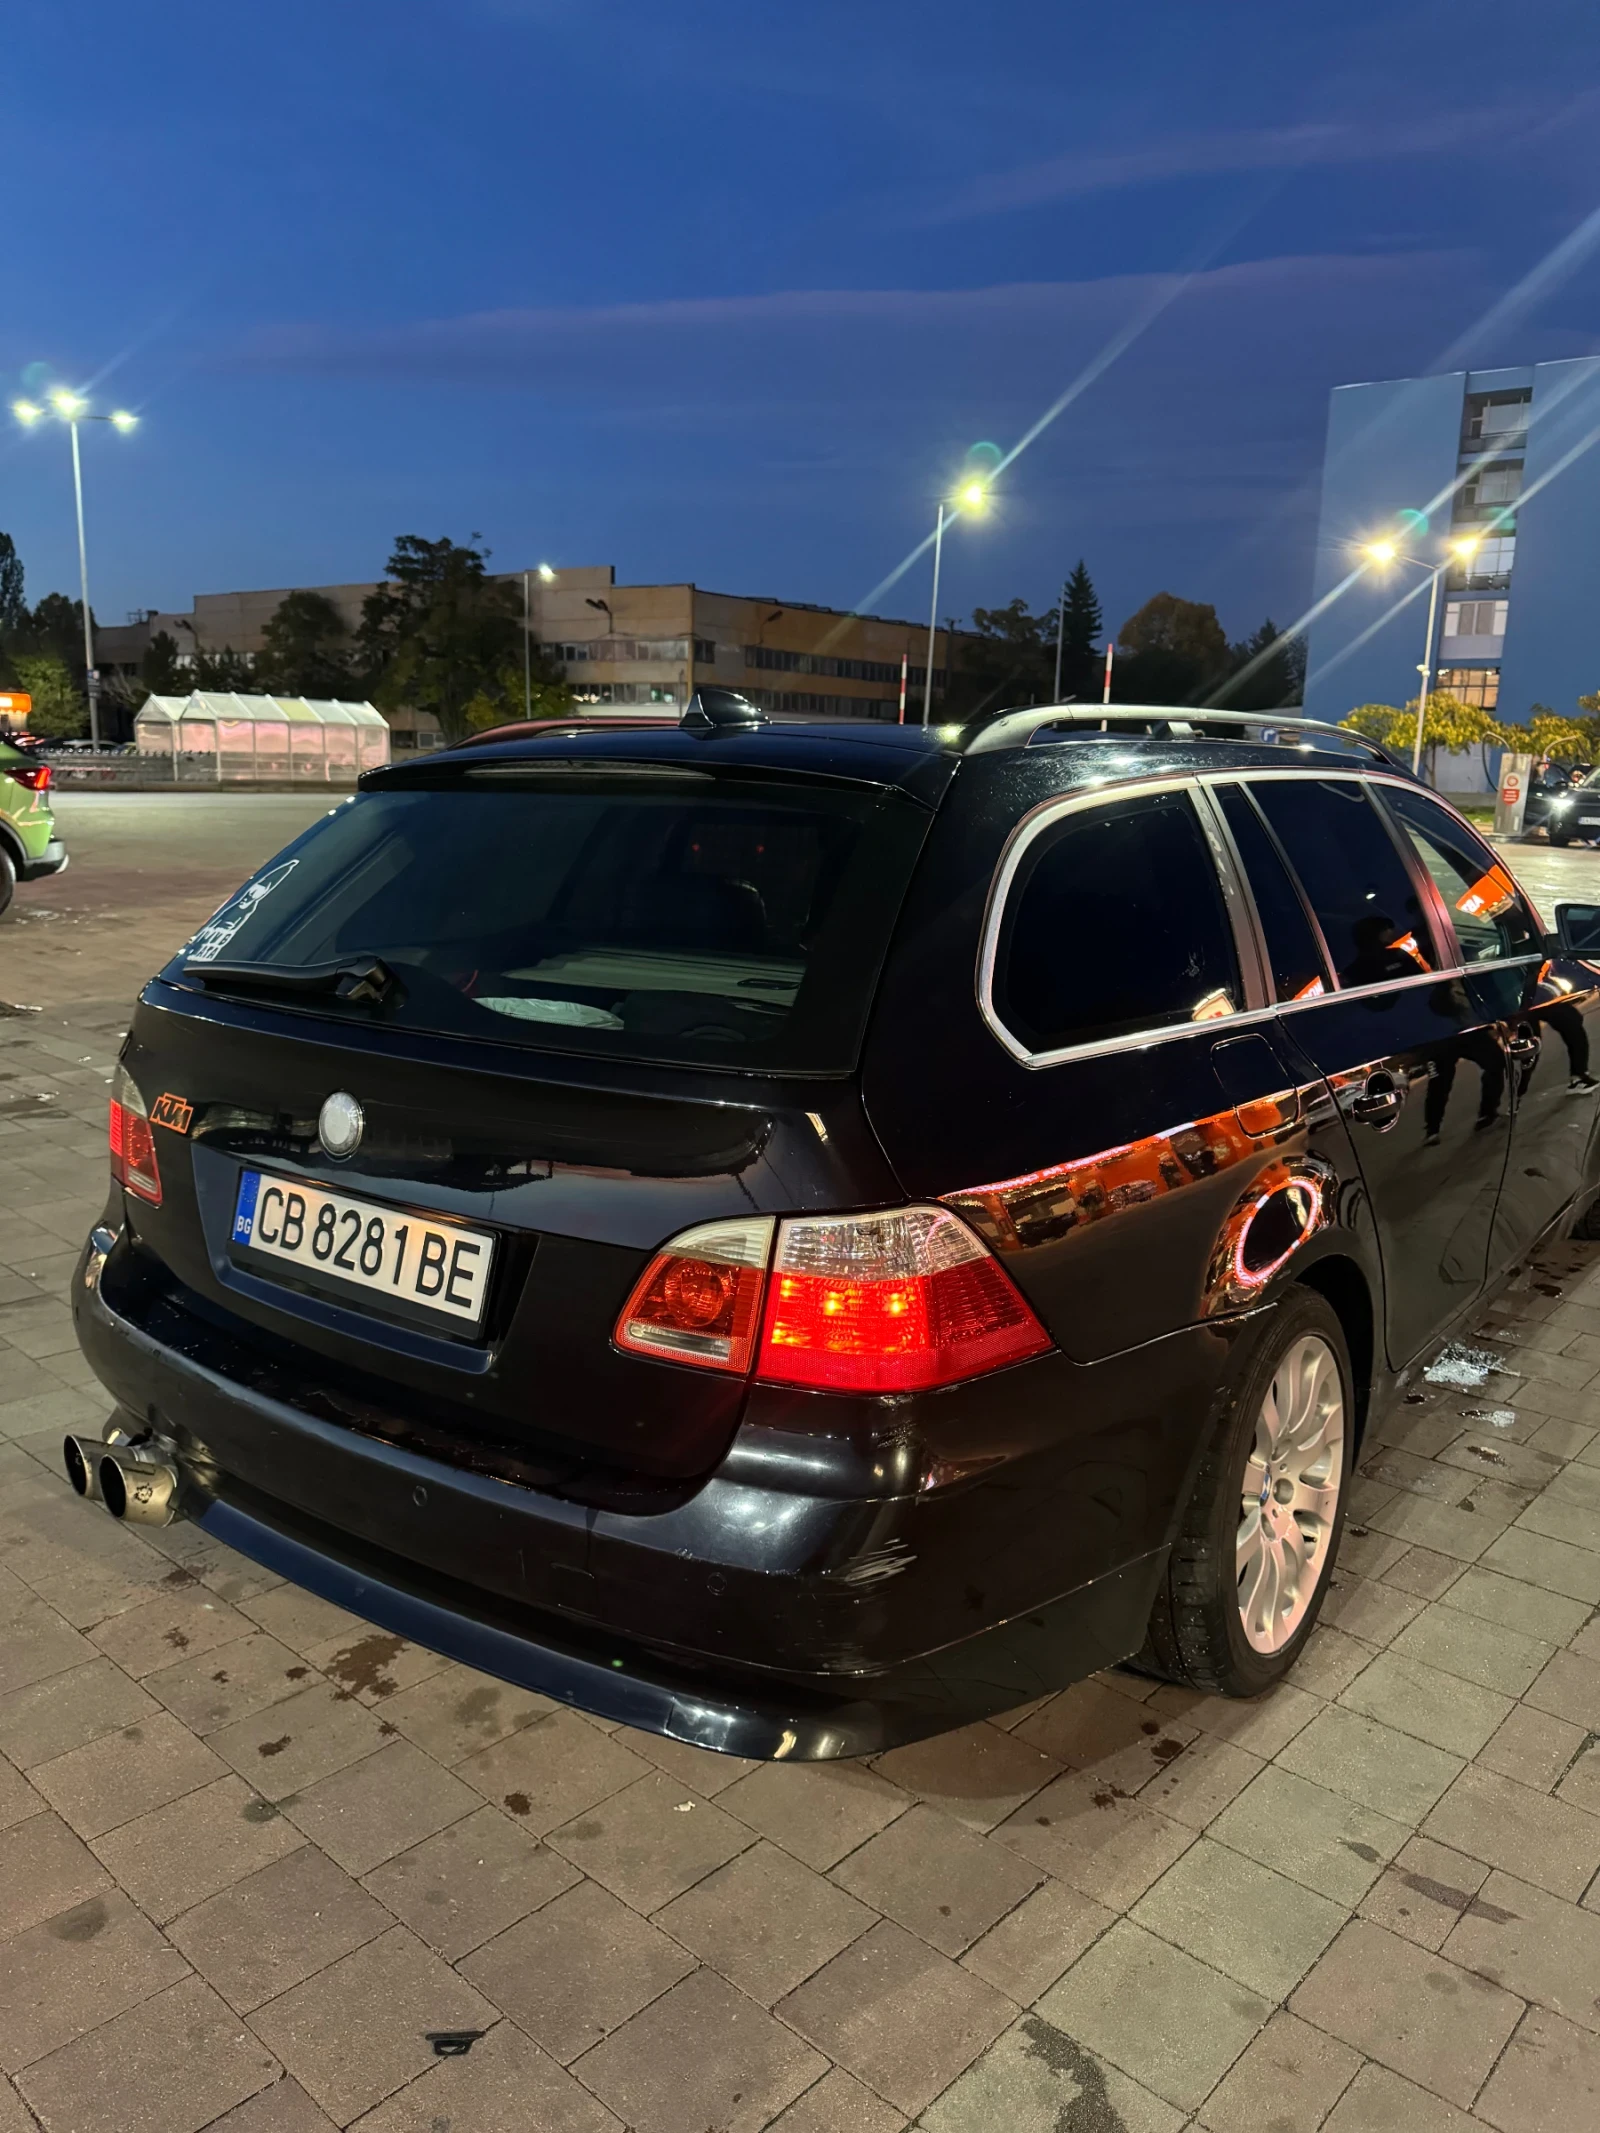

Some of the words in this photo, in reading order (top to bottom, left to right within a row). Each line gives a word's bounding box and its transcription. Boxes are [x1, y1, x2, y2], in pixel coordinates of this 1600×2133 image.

[149, 1092, 194, 1134] KTM
[237, 1215, 252, 1234] BG
[258, 1186, 306, 1250] CB
[312, 1202, 409, 1286] 8281
[415, 1231, 481, 1309] BE
